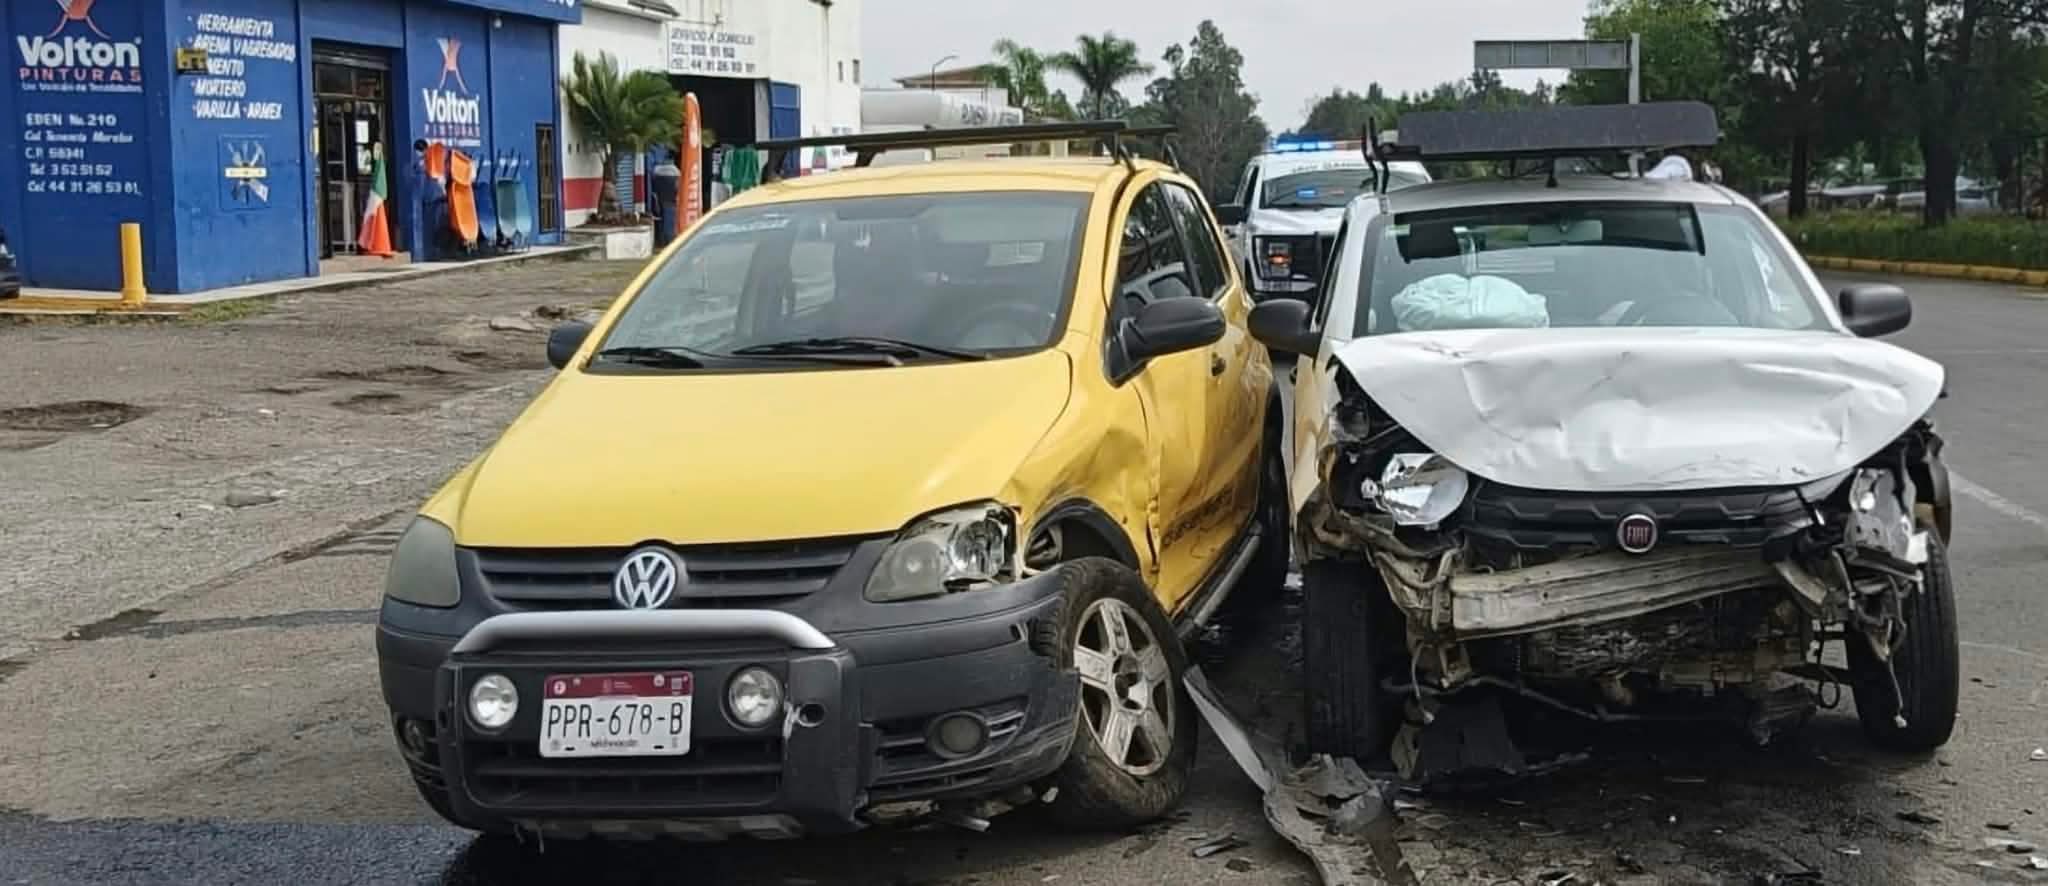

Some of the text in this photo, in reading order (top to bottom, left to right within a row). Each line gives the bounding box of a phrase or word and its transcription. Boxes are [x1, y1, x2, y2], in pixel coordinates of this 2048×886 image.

[197, 14, 274, 39] HERRAMIENTA
[17, 36, 139, 67] Volton
[19, 67, 142, 82] PINTURAS
[207, 57, 245, 77] MENTO
[195, 79, 247, 97] MORTERO
[196, 100, 282, 119] VARILLA ARMEX
[423, 88, 480, 124] Volton
[26, 113, 62, 126] EDEN
[48, 180, 65, 192] 44
[1627, 526, 1649, 544] FIAT
[616, 551, 675, 609] VW
[547, 702, 684, 739] PPR-678-B
